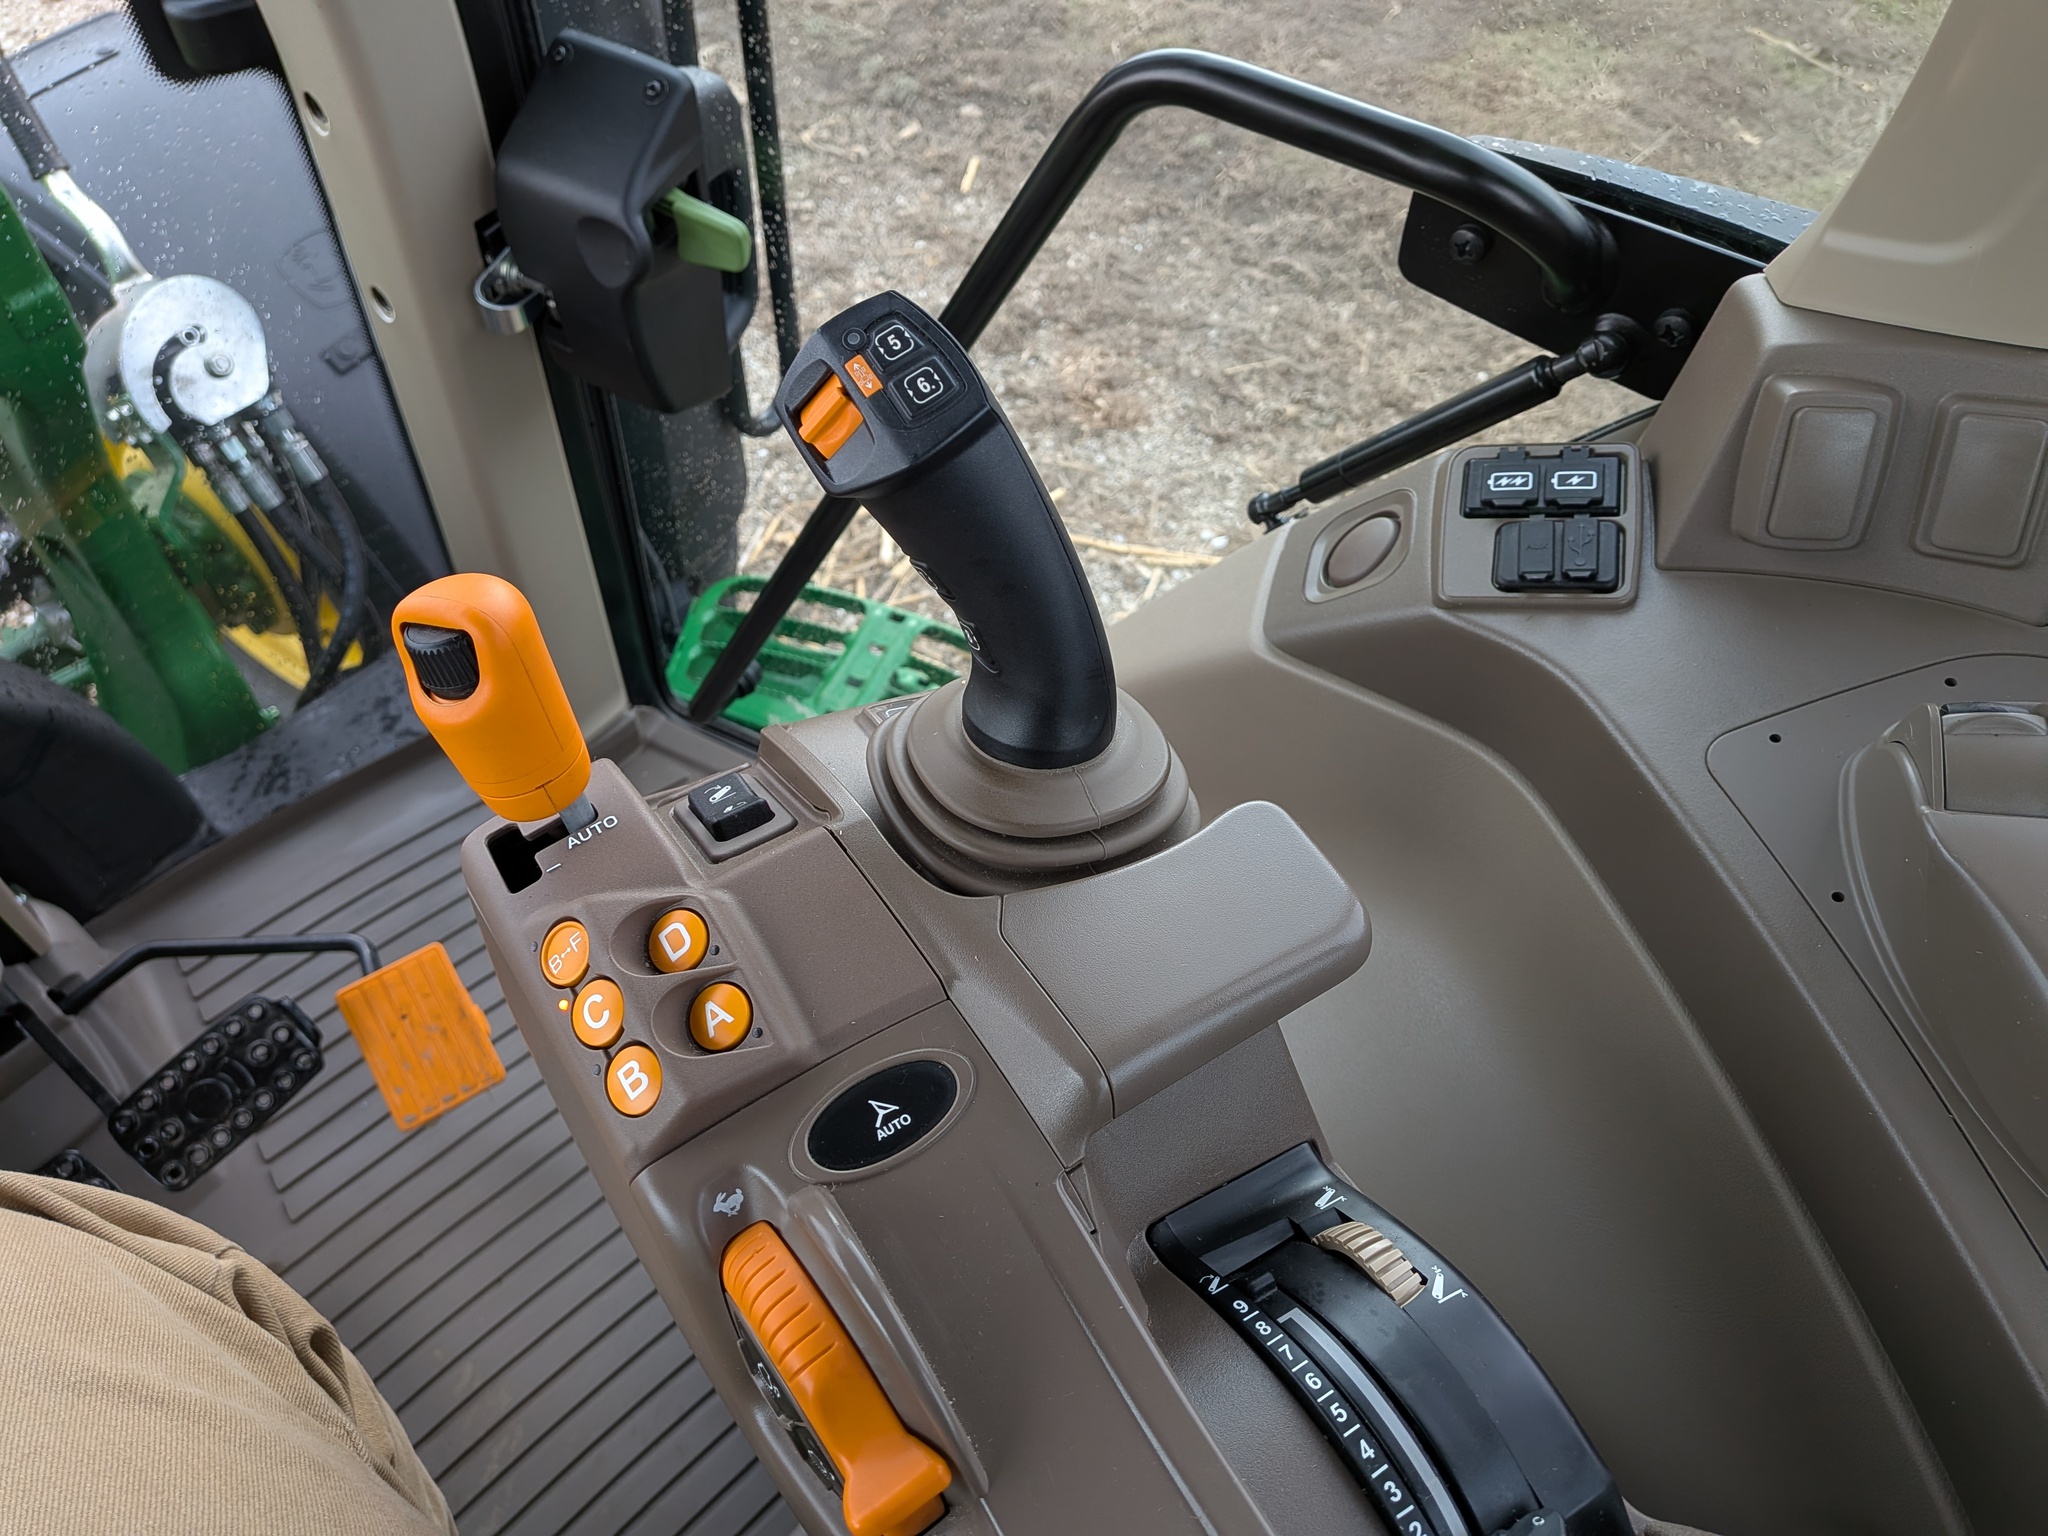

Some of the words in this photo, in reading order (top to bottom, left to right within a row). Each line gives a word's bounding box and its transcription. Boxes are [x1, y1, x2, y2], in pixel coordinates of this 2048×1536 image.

[886, 334, 902, 351] 5
[567, 814, 619, 850] AUTO
[658, 921, 692, 963] D
[582, 993, 610, 1029] C
[704, 1000, 735, 1039] A
[616, 1059, 649, 1101] B
[875, 1113, 912, 1142] AUTO
[1232, 1300, 1249, 1314] 9
[1255, 1320, 1272, 1336] 8
[1277, 1342, 1294, 1361] 7
[1304, 1372, 1322, 1390] 6
[1329, 1401, 1348, 1423] 5
[1358, 1438, 1375, 1460] 4
[1383, 1480, 1402, 1502] 3
[1408, 1520, 1428, 1536] 2
